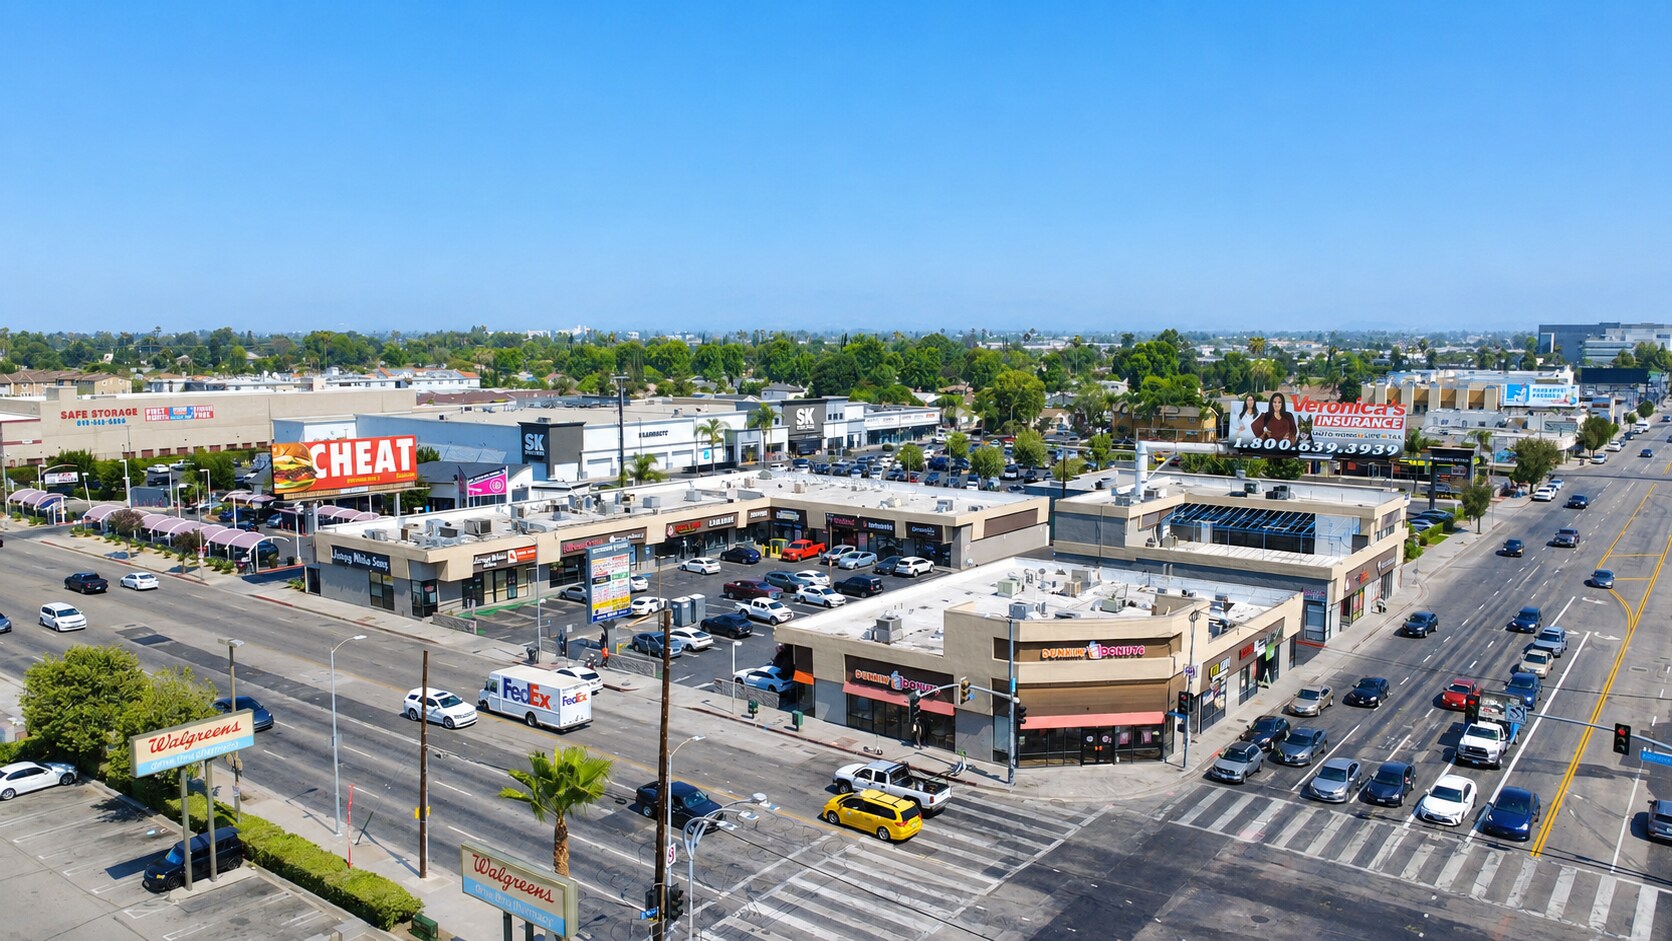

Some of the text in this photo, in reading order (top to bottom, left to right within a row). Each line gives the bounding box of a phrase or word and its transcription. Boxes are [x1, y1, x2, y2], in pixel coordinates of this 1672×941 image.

[61, 408, 138, 419] SAFE STORAGE
[1291, 396, 1406, 416] Veronica's
[796, 408, 815, 425] SK
[1317, 416, 1402, 429] INSURANCE
[525, 433, 544, 451] SK
[1234, 438, 1399, 456] 1.800.639.3939
[310, 438, 414, 478] CHEAT
[503, 678, 551, 710] FedEx
[562, 692, 588, 706] FedEx
[148, 721, 241, 750] Walgreens
[473, 853, 554, 903] Walgreens
